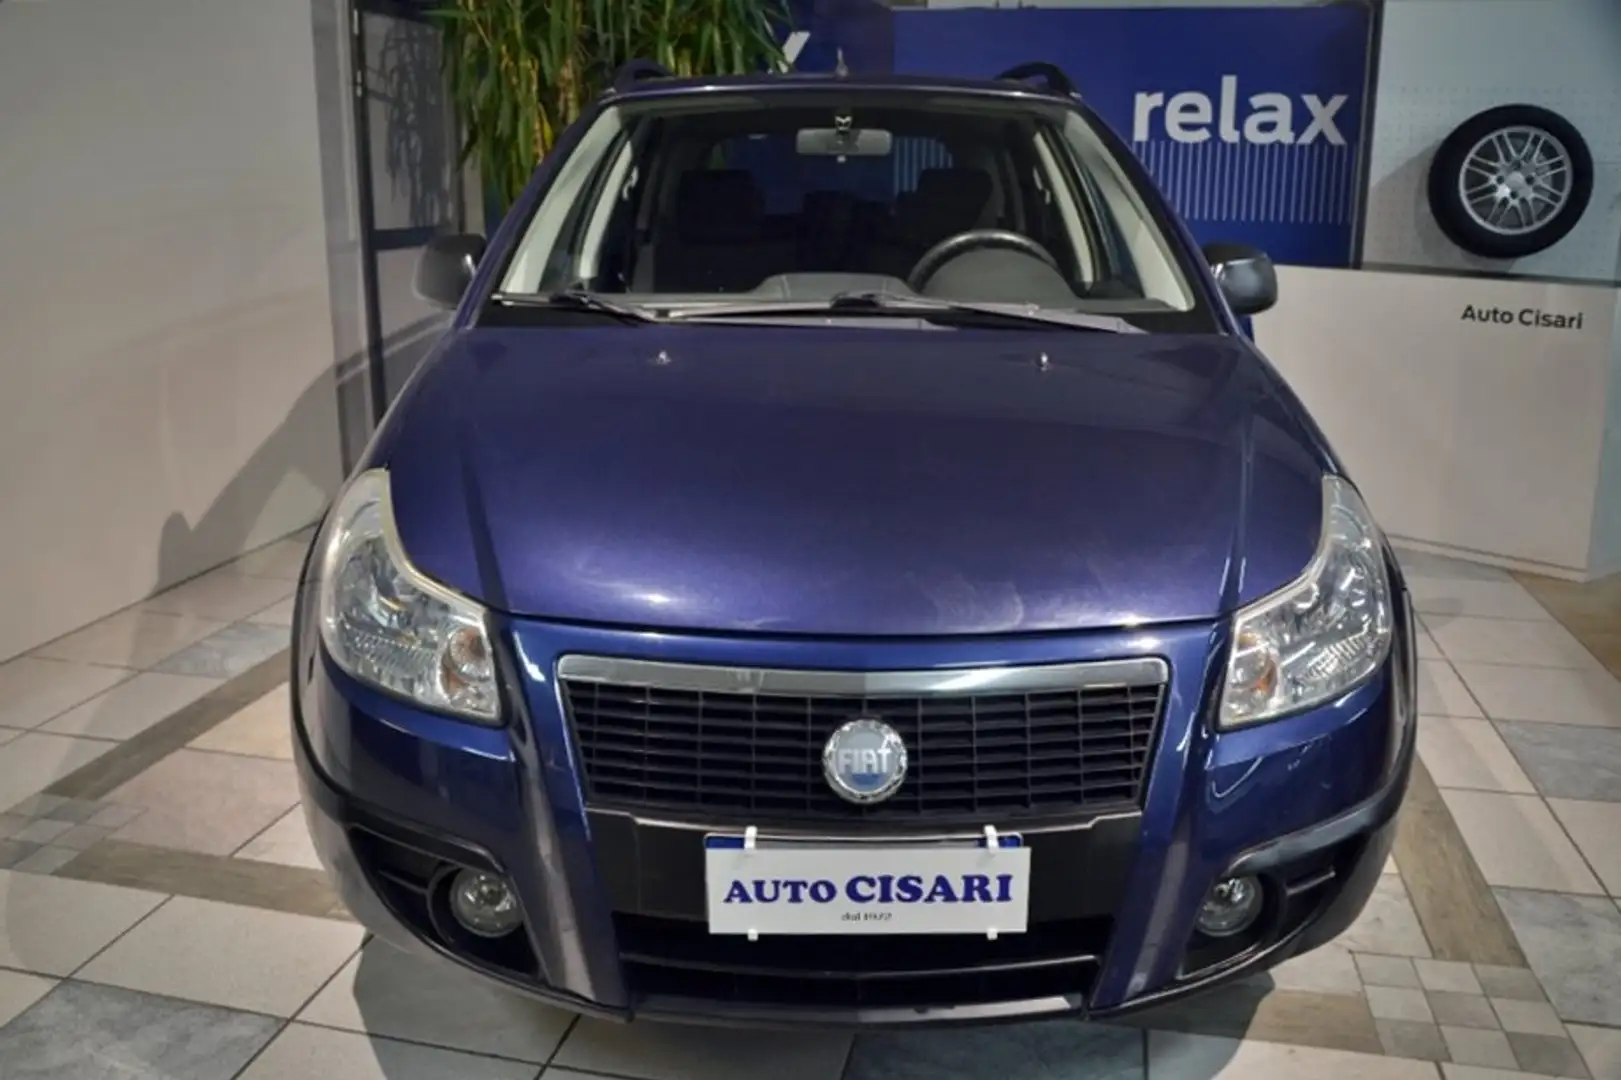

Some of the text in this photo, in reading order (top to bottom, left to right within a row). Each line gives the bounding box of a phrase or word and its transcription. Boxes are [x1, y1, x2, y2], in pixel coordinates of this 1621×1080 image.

[1133, 74, 1349, 145] relax
[1460, 304, 1583, 330] Auto Cisari
[838, 747, 891, 774] FIAT
[723, 874, 1013, 904] AUTO CISARI
